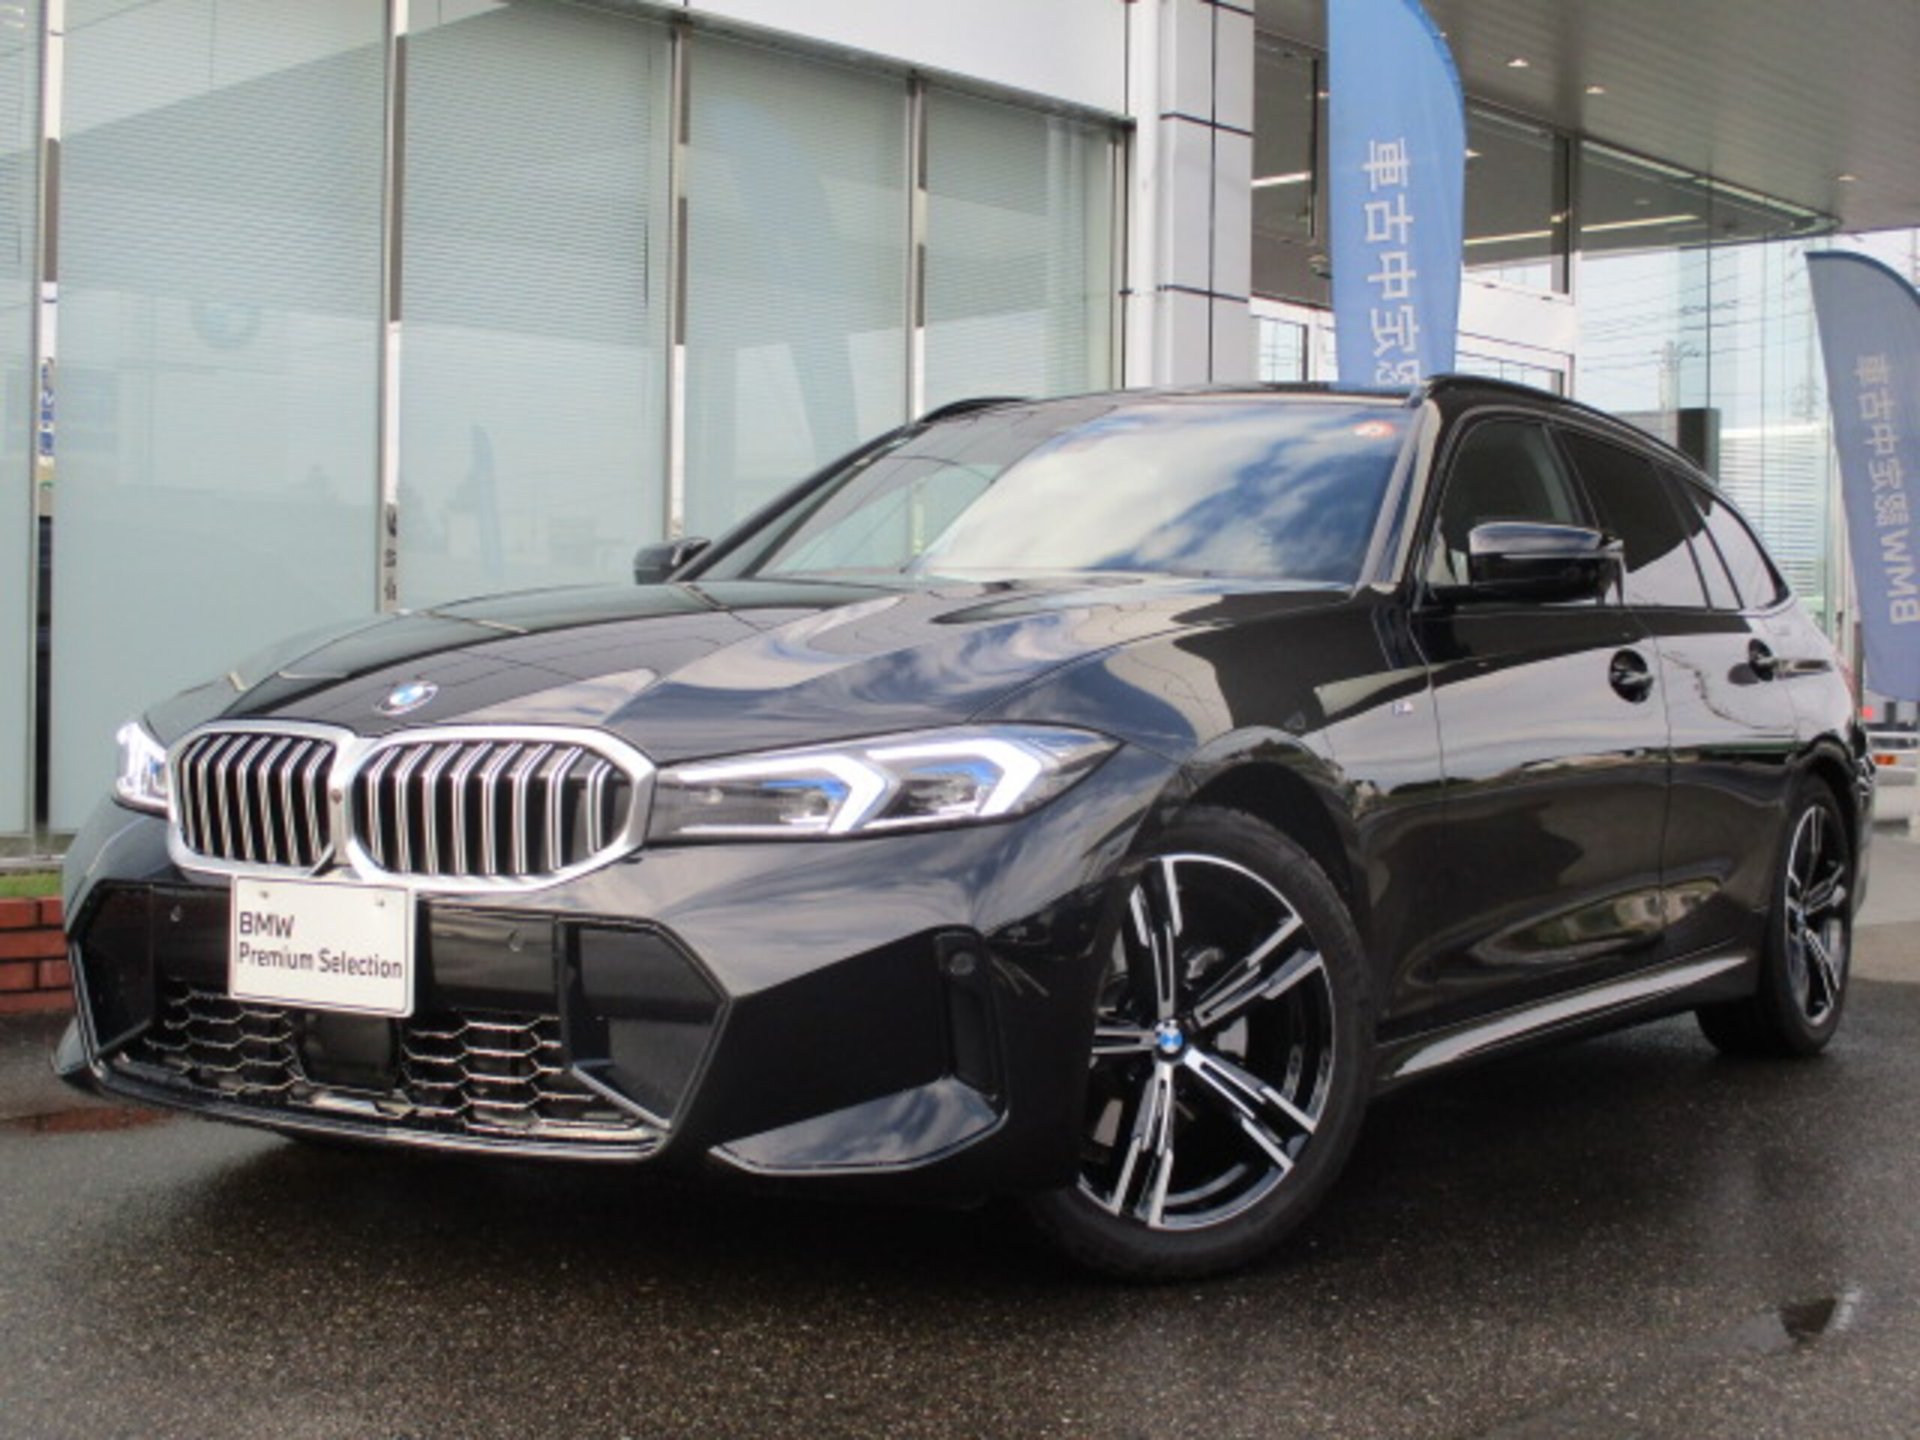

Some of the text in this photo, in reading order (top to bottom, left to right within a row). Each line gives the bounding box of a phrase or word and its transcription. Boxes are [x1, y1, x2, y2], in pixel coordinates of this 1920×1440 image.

[239, 911, 294, 937] BMW
[239, 942, 402, 979] Premium Selection
